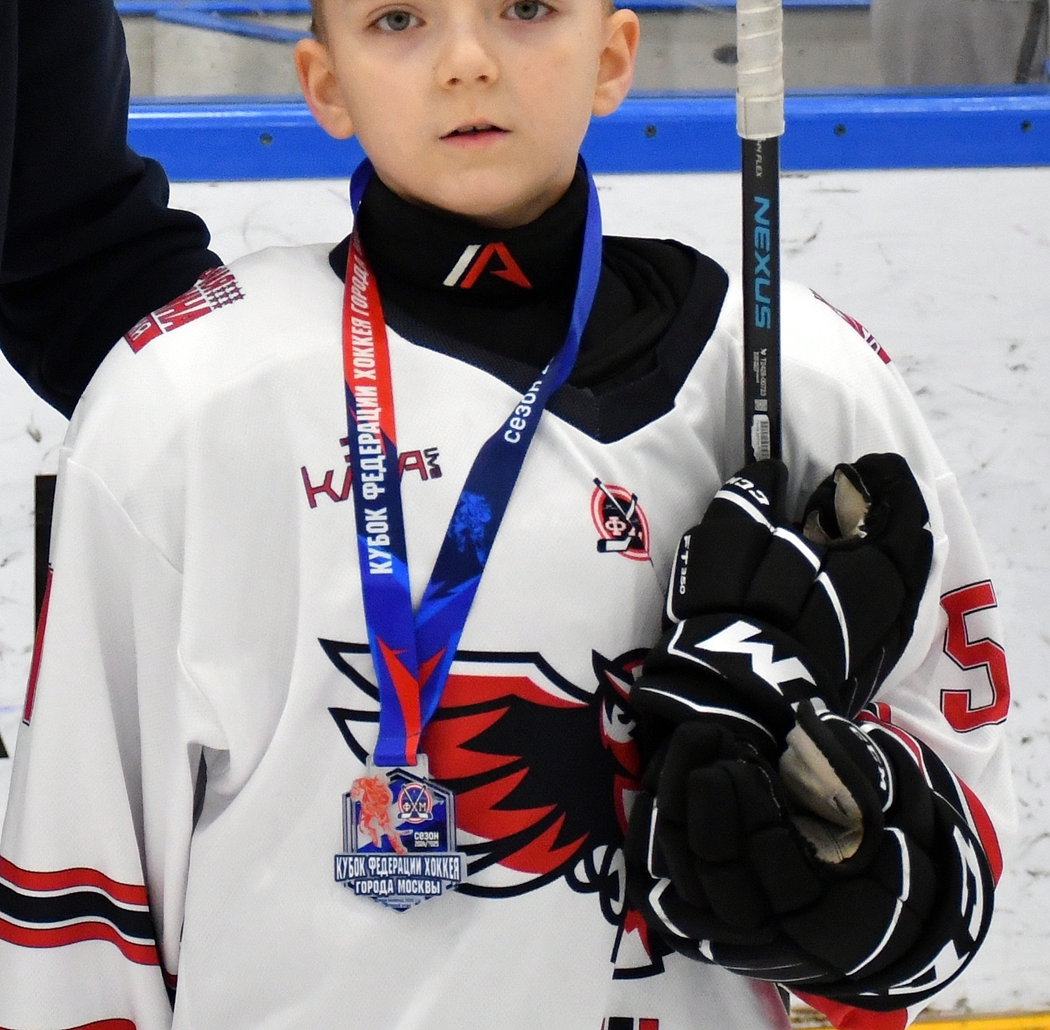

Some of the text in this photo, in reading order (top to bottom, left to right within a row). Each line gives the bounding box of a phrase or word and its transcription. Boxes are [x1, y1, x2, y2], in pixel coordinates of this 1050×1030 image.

[753, 195, 771, 330] NEXUS
[351, 316, 377, 380] ХОККЕЯ
[354, 385, 387, 500] ФЕДЕРАЦИИ
[364, 507, 393, 575] КУБОК
[336, 856, 460, 881] КУБОК ФЕДЕРАЦИИ ХОККЕЯ
[355, 880, 440, 896] ГОРОДА МОСКВЫ
